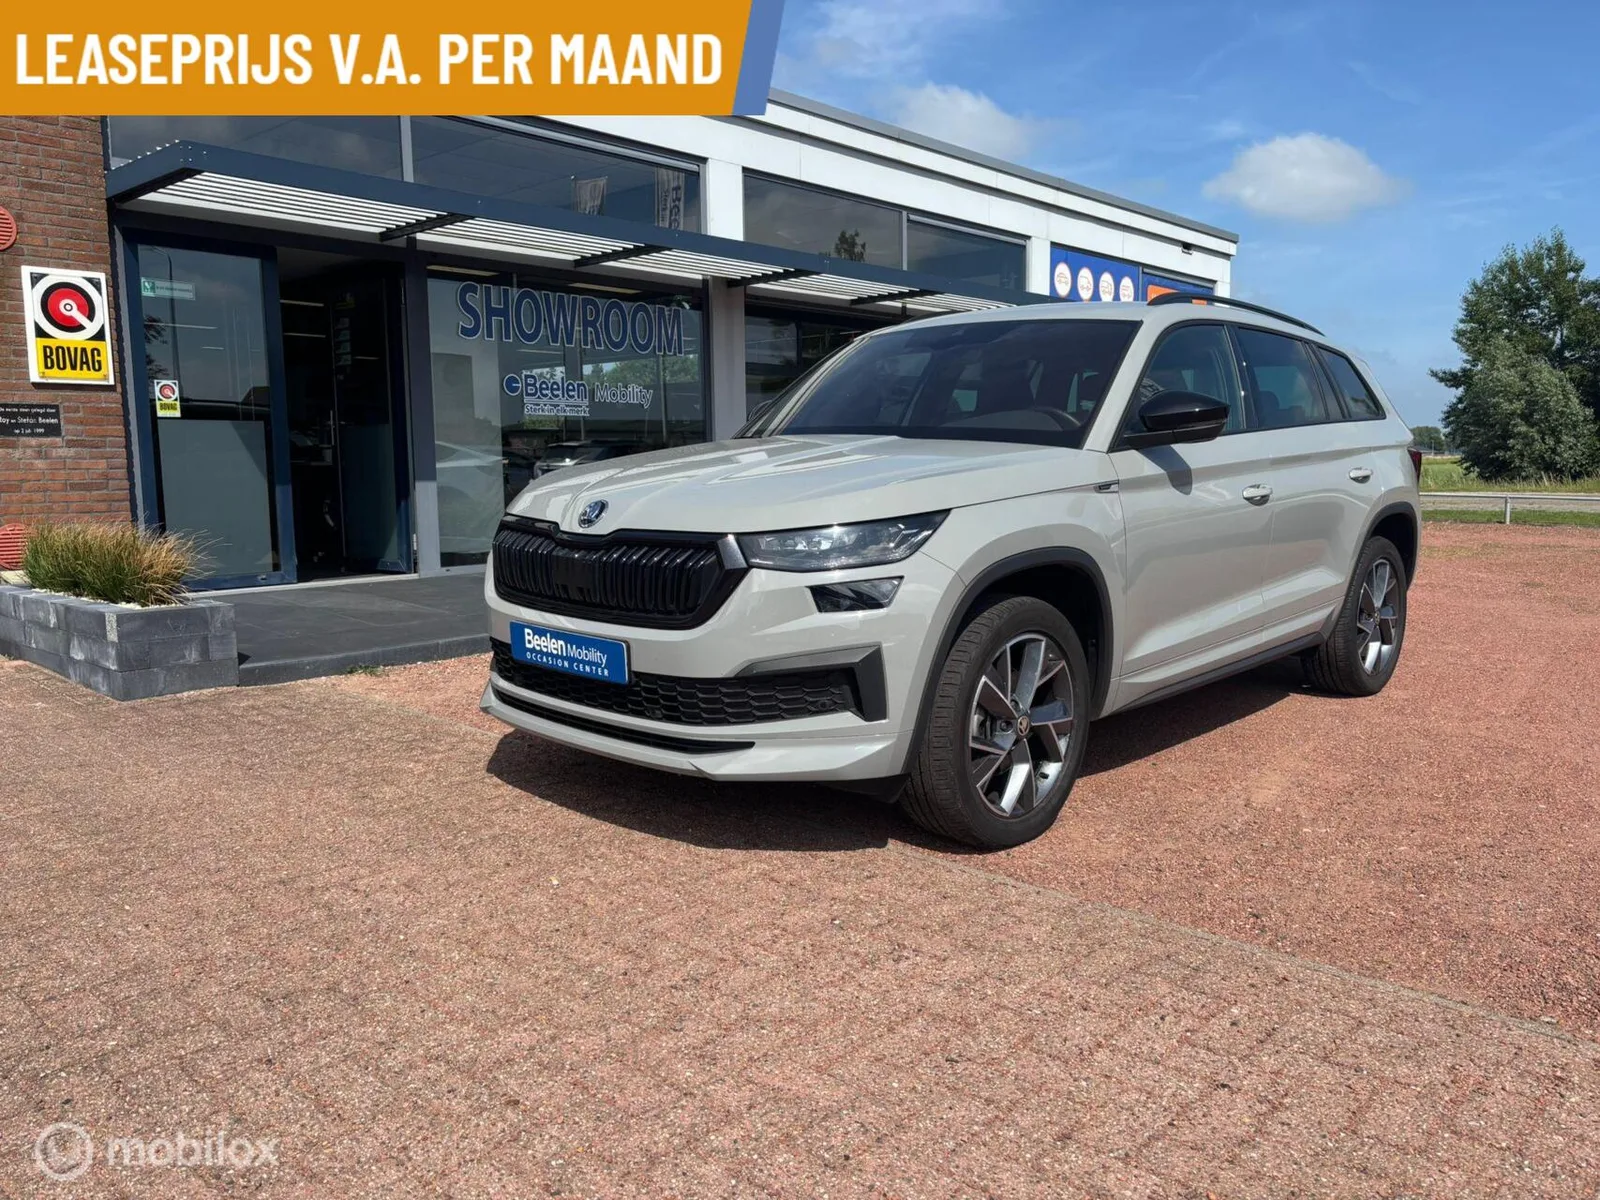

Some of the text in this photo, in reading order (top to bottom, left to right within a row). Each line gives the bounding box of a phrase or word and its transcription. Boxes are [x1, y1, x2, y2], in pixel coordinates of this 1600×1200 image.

[458, 281, 684, 356] SHOWROOM
[43, 346, 102, 371] BOVAG
[524, 374, 653, 409] Beelen Mobility
[159, 402, 178, 411] BOVAG
[524, 404, 545, 414] Sterk
[524, 628, 607, 667] Beelen Mobility
[526, 651, 609, 677] OCCASION CENTER
